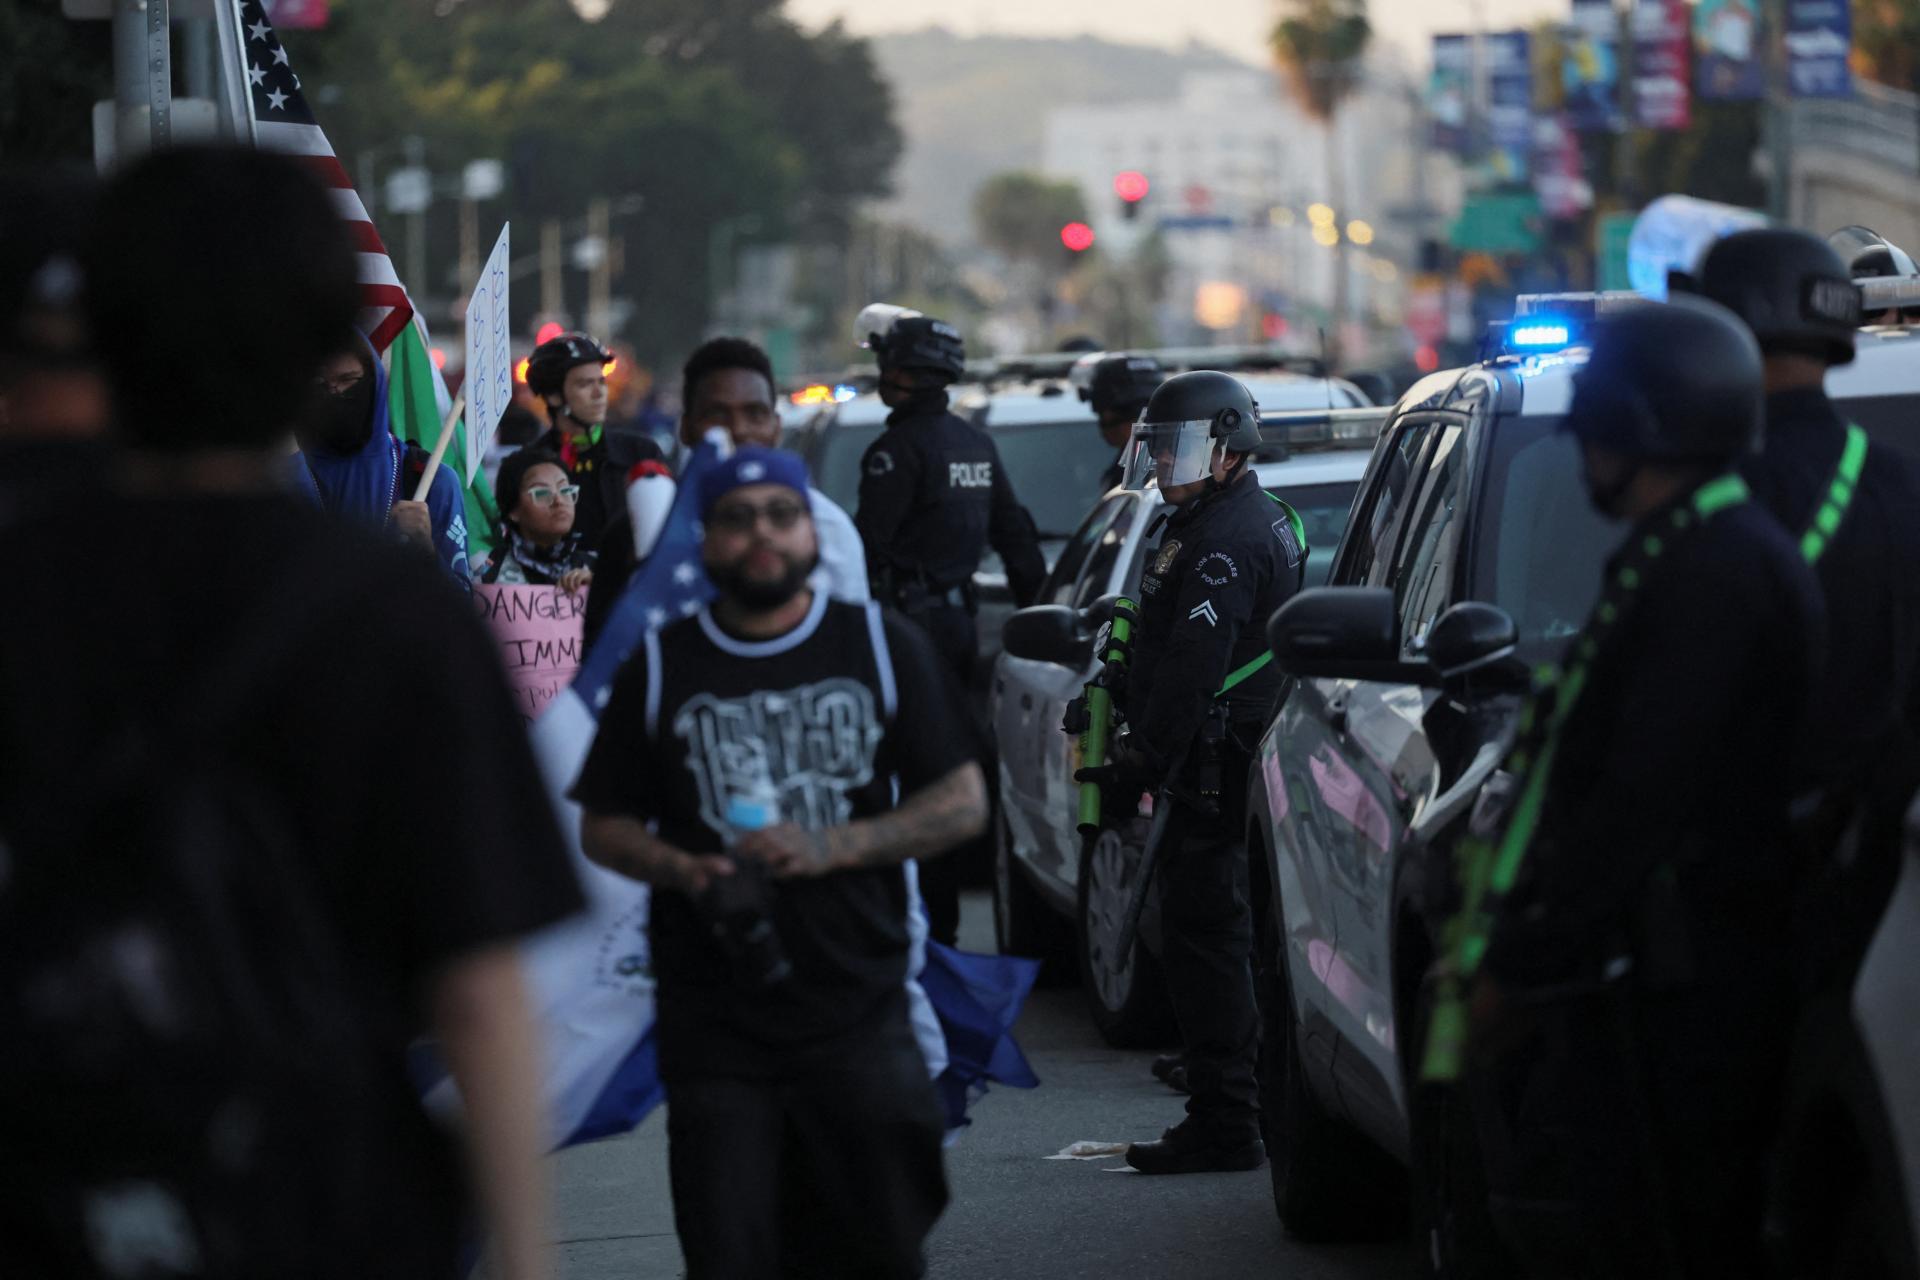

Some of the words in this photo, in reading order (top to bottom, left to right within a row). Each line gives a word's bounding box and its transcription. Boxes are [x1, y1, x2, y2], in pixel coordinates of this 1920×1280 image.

[474, 287, 487, 349] GO
[474, 345, 488, 451] HOME
[949, 461, 992, 488] POLICE
[1194, 556, 1208, 571] LOS
[1210, 551, 1238, 577] ANGELES
[1200, 572, 1229, 585] POLICE
[503, 636, 583, 670] IMM
